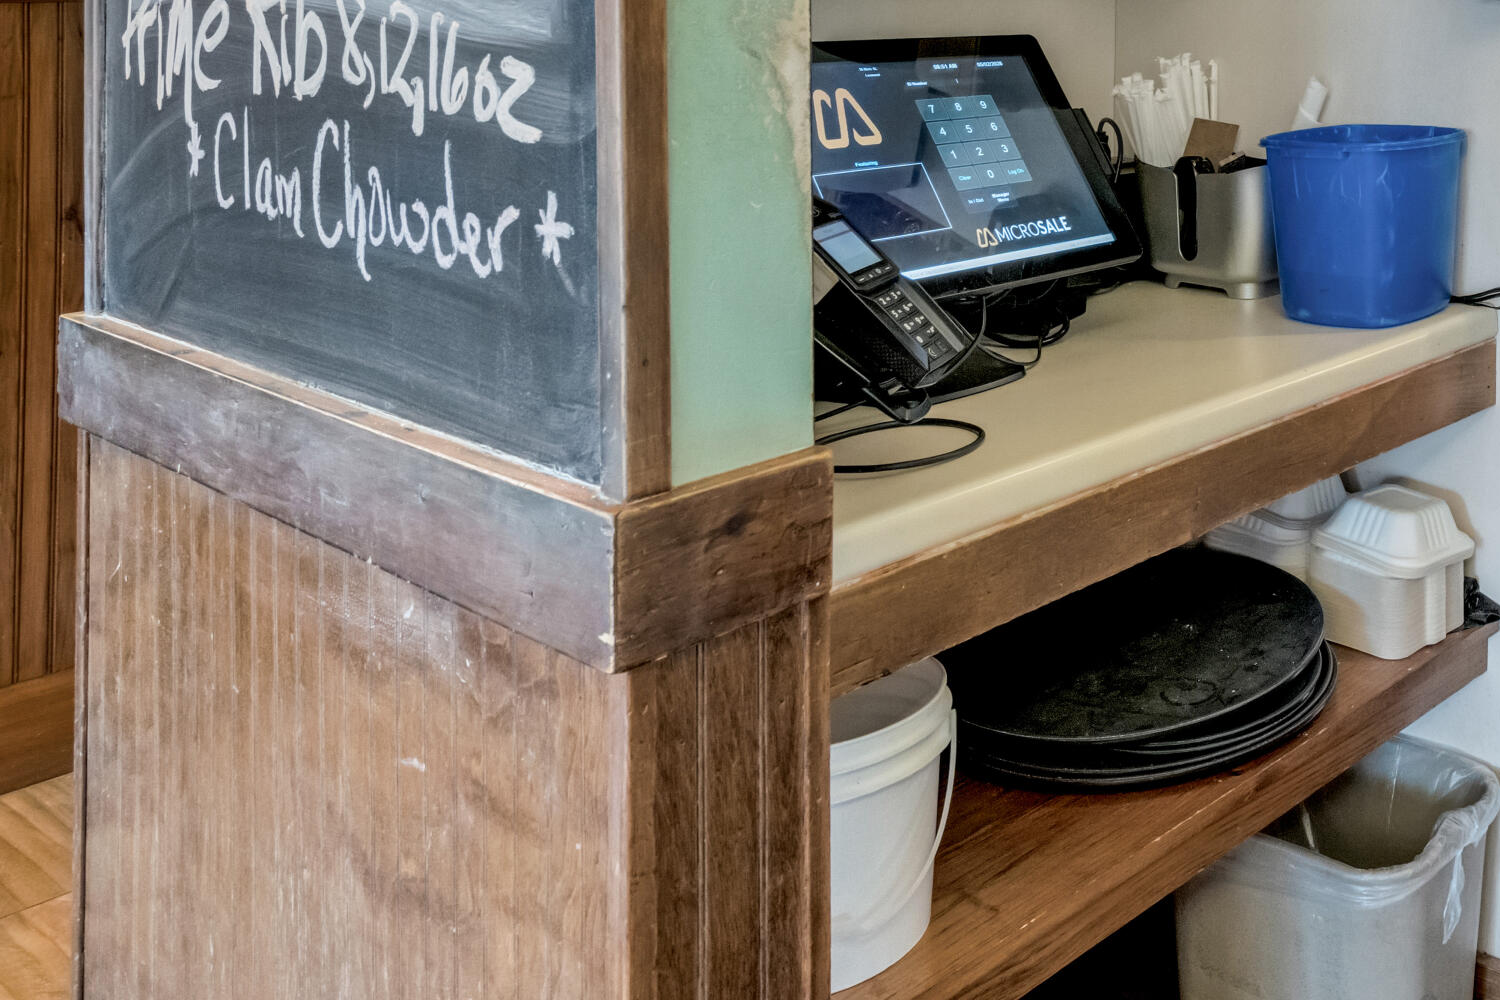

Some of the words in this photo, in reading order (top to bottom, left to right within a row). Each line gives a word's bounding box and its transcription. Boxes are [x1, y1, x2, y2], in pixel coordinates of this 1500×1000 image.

[927, 104, 935, 114] 7
[954, 102, 963, 112] 8
[979, 100, 988, 110] 9
[939, 127, 947, 136] 4
[965, 124, 973, 134] 5
[990, 122, 998, 132] 6
[950, 150, 957, 159] 1
[975, 147, 984, 157] 2
[1001, 144, 1009, 153] 3
[987, 169, 995, 179] 0
[312, 118, 520, 282] Chowder
[996, 215, 1072, 243] MICROSALE
